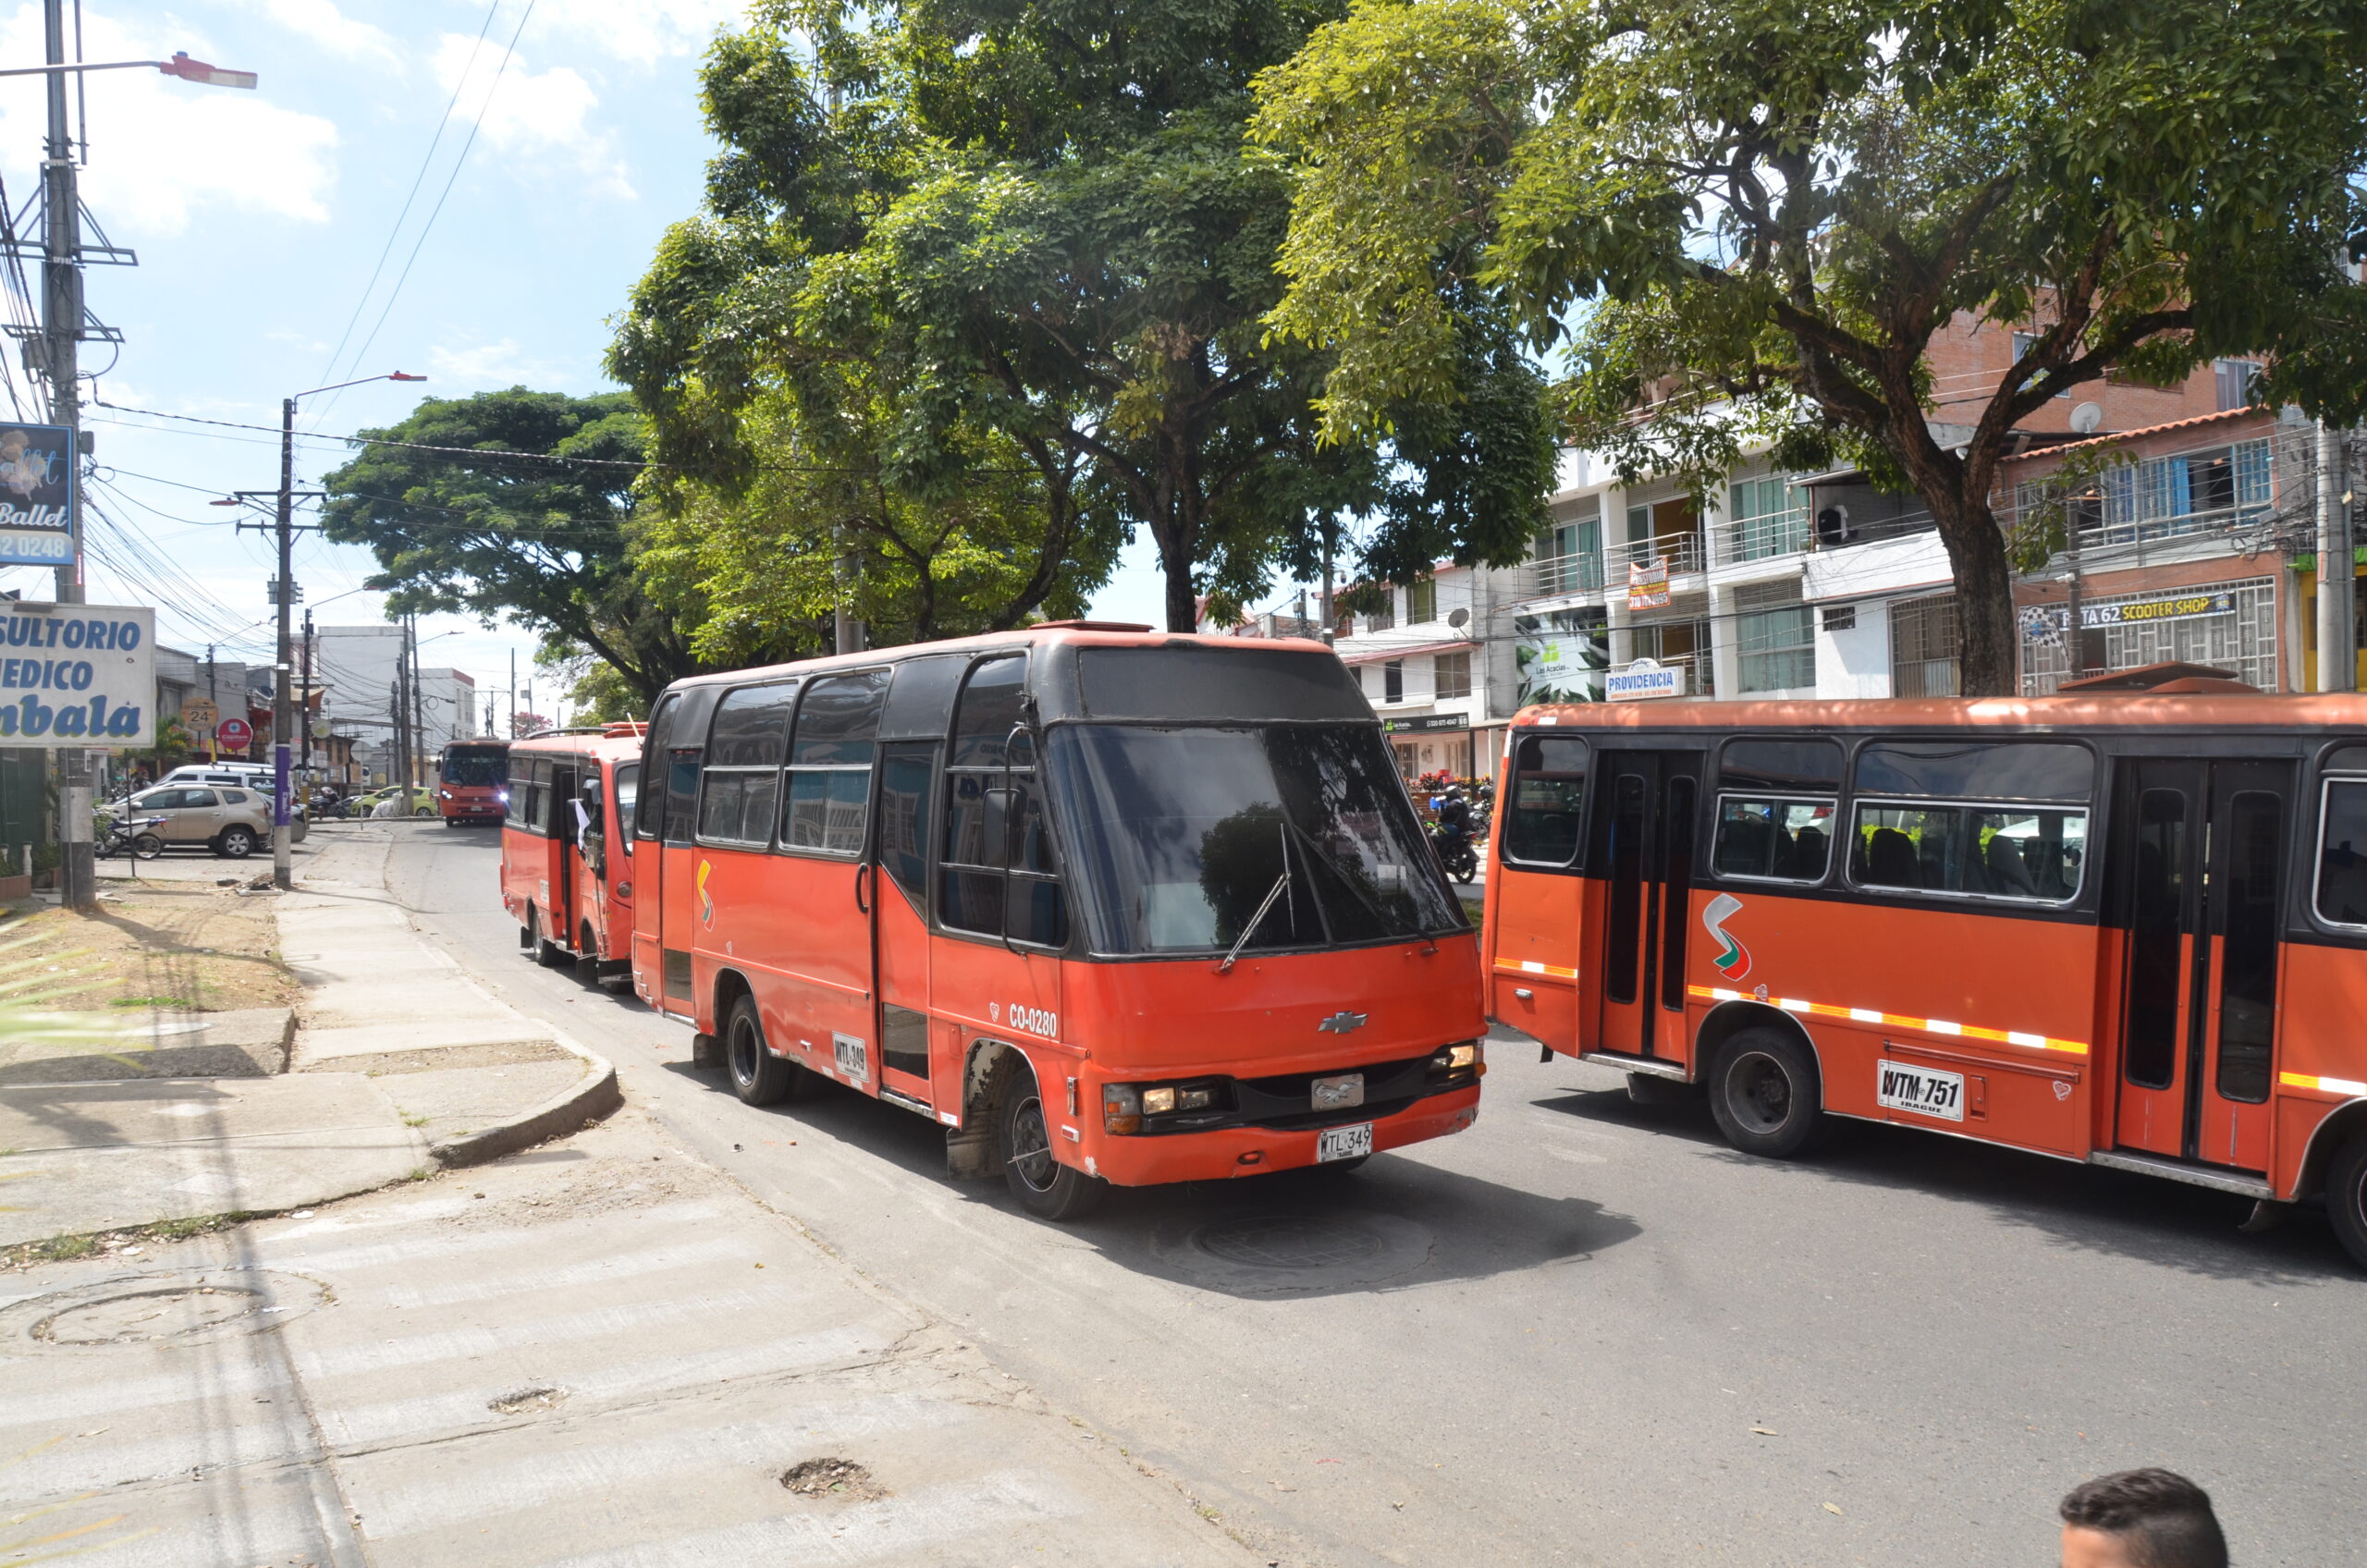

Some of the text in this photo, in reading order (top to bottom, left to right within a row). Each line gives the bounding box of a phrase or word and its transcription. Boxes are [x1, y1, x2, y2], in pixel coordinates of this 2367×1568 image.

[0, 502, 67, 527] Ballet
[0, 535, 66, 558] 2 0248
[2063, 609, 2098, 626] RTA
[2101, 606, 2121, 622] 62
[2123, 601, 2174, 620] SCOOTER
[2177, 597, 2209, 614] SHOP
[0, 658, 93, 691] EDICO
[1608, 672, 1674, 692] PROVIDENCIA
[190, 711, 209, 722] 24
[1010, 1003, 1057, 1037] CO-0280
[1900, 1100, 1943, 1113] IBAGUE
